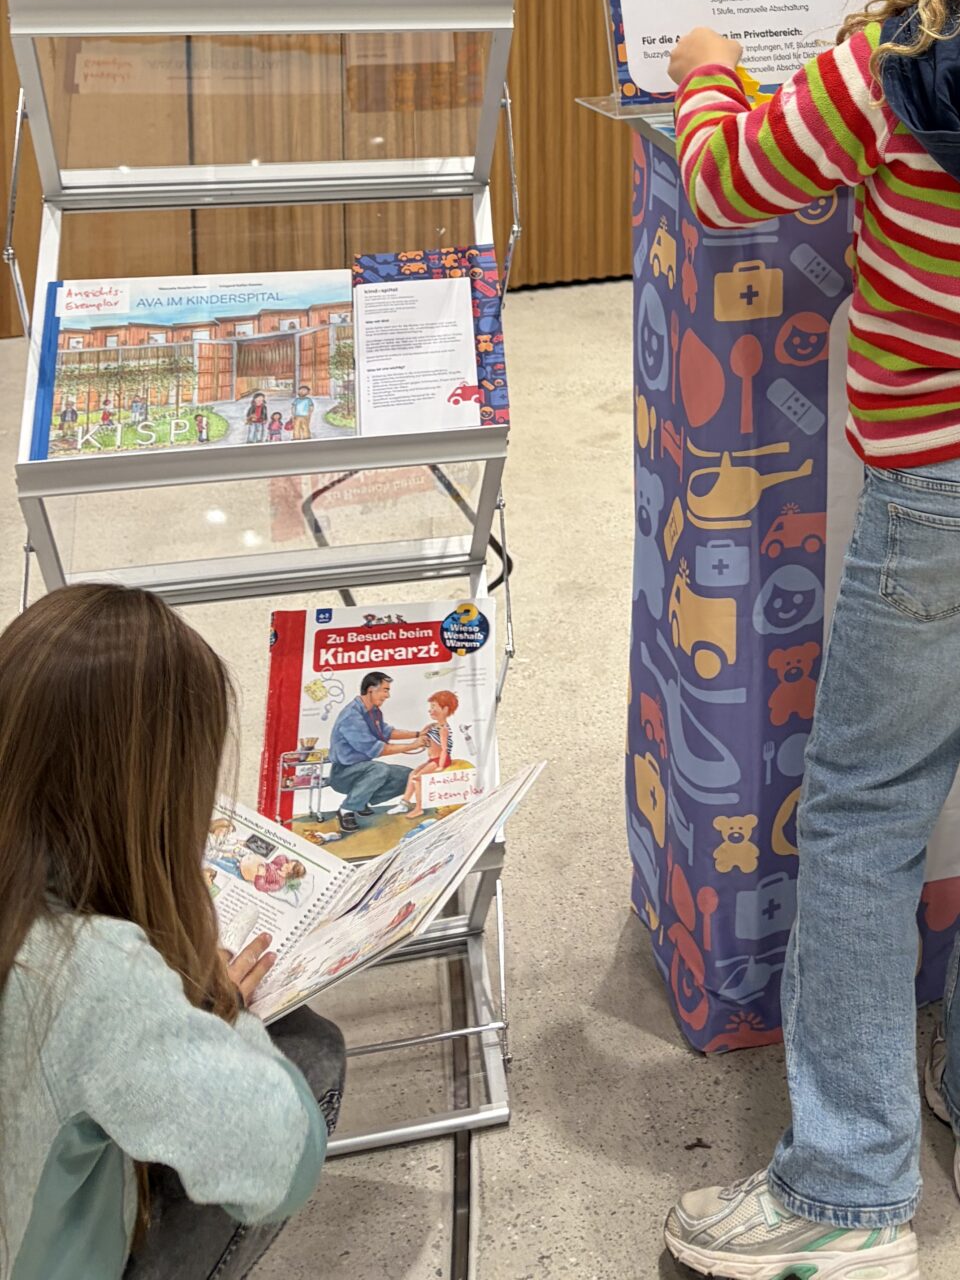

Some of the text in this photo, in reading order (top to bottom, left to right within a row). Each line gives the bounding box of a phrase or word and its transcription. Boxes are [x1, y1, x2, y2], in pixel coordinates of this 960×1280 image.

[737, 5, 768, 14] manuelle
[769, 4, 809, 13] Abschaltung
[730, 30, 742, 40] im
[743, 27, 803, 40] Privatbereich:
[642, 36, 657, 45] Für
[658, 35, 673, 45] die
[746, 43, 782, 53] Impfungen,
[792, 51, 801, 59] für
[776, 63, 801, 71] Abscha
[136, 292, 283, 308] AVA IM KINDERSPITAL
[65, 300, 120, 311] Exemplar
[450, 623, 480, 633] Wieso
[327, 628, 433, 645] Zu Besuch beim
[443, 631, 484, 642] Weshalb
[445, 638, 481, 648] Warum
[319, 641, 440, 666] Kinderarzt
